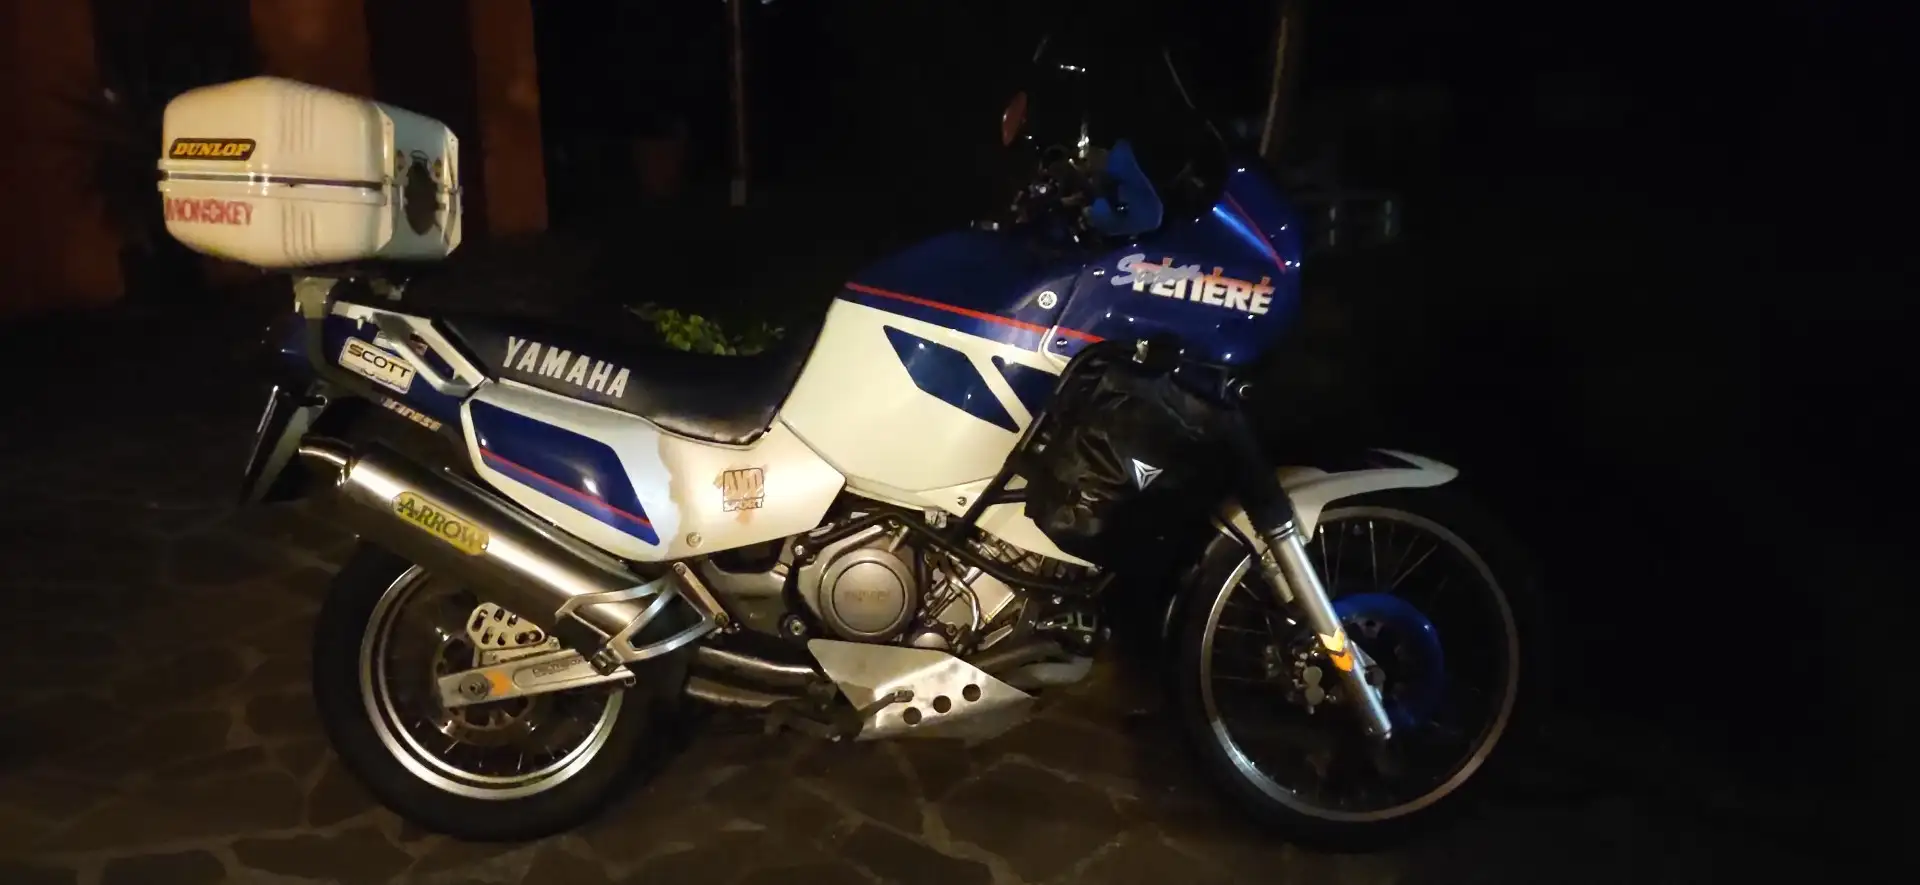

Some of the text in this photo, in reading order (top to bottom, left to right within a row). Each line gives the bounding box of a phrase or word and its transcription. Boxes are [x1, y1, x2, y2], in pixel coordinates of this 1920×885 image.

[174, 142, 251, 156] DUNLOP
[347, 343, 411, 378] SCOTT
[503, 336, 630, 398] YAMAHA
[397, 498, 486, 548] ARROW
